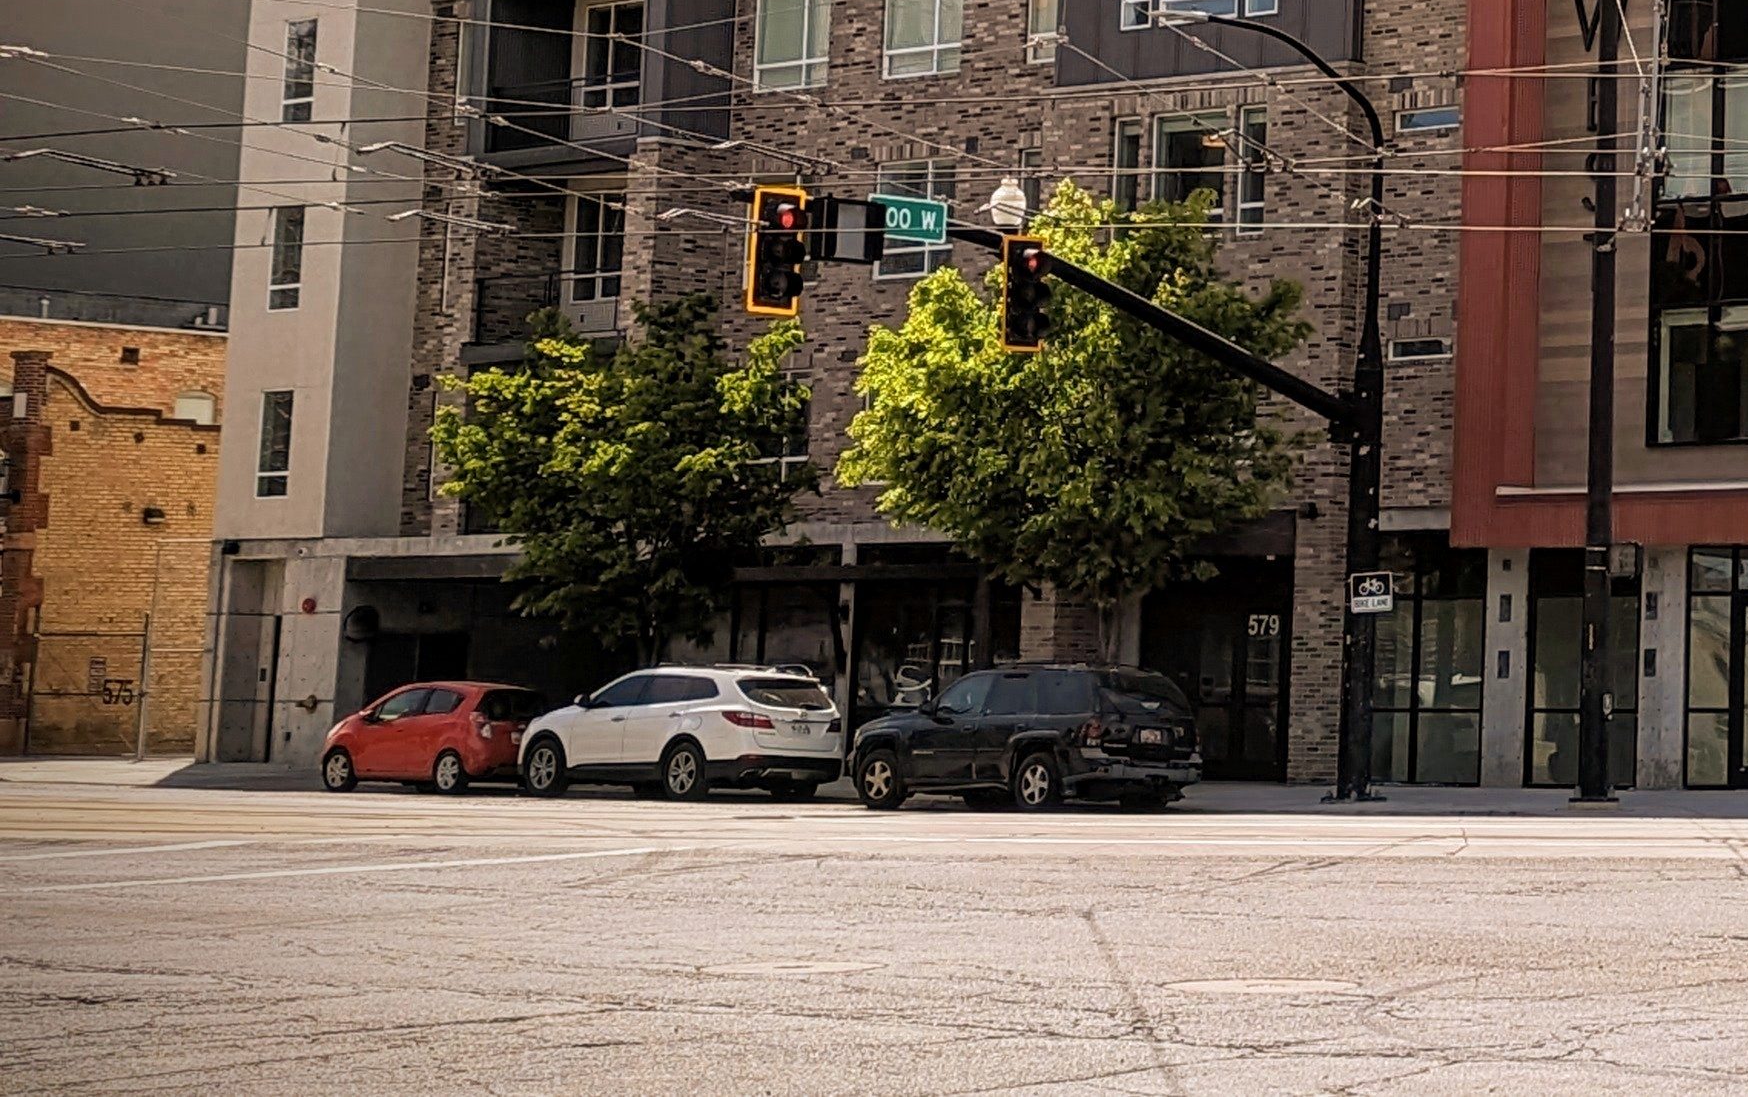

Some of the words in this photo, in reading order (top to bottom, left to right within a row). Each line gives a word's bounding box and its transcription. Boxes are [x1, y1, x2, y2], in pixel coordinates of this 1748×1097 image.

[885, 206, 912, 229] 00
[921, 209, 937, 232] W
[1248, 614, 1280, 636] 579
[103, 679, 134, 706] 575
